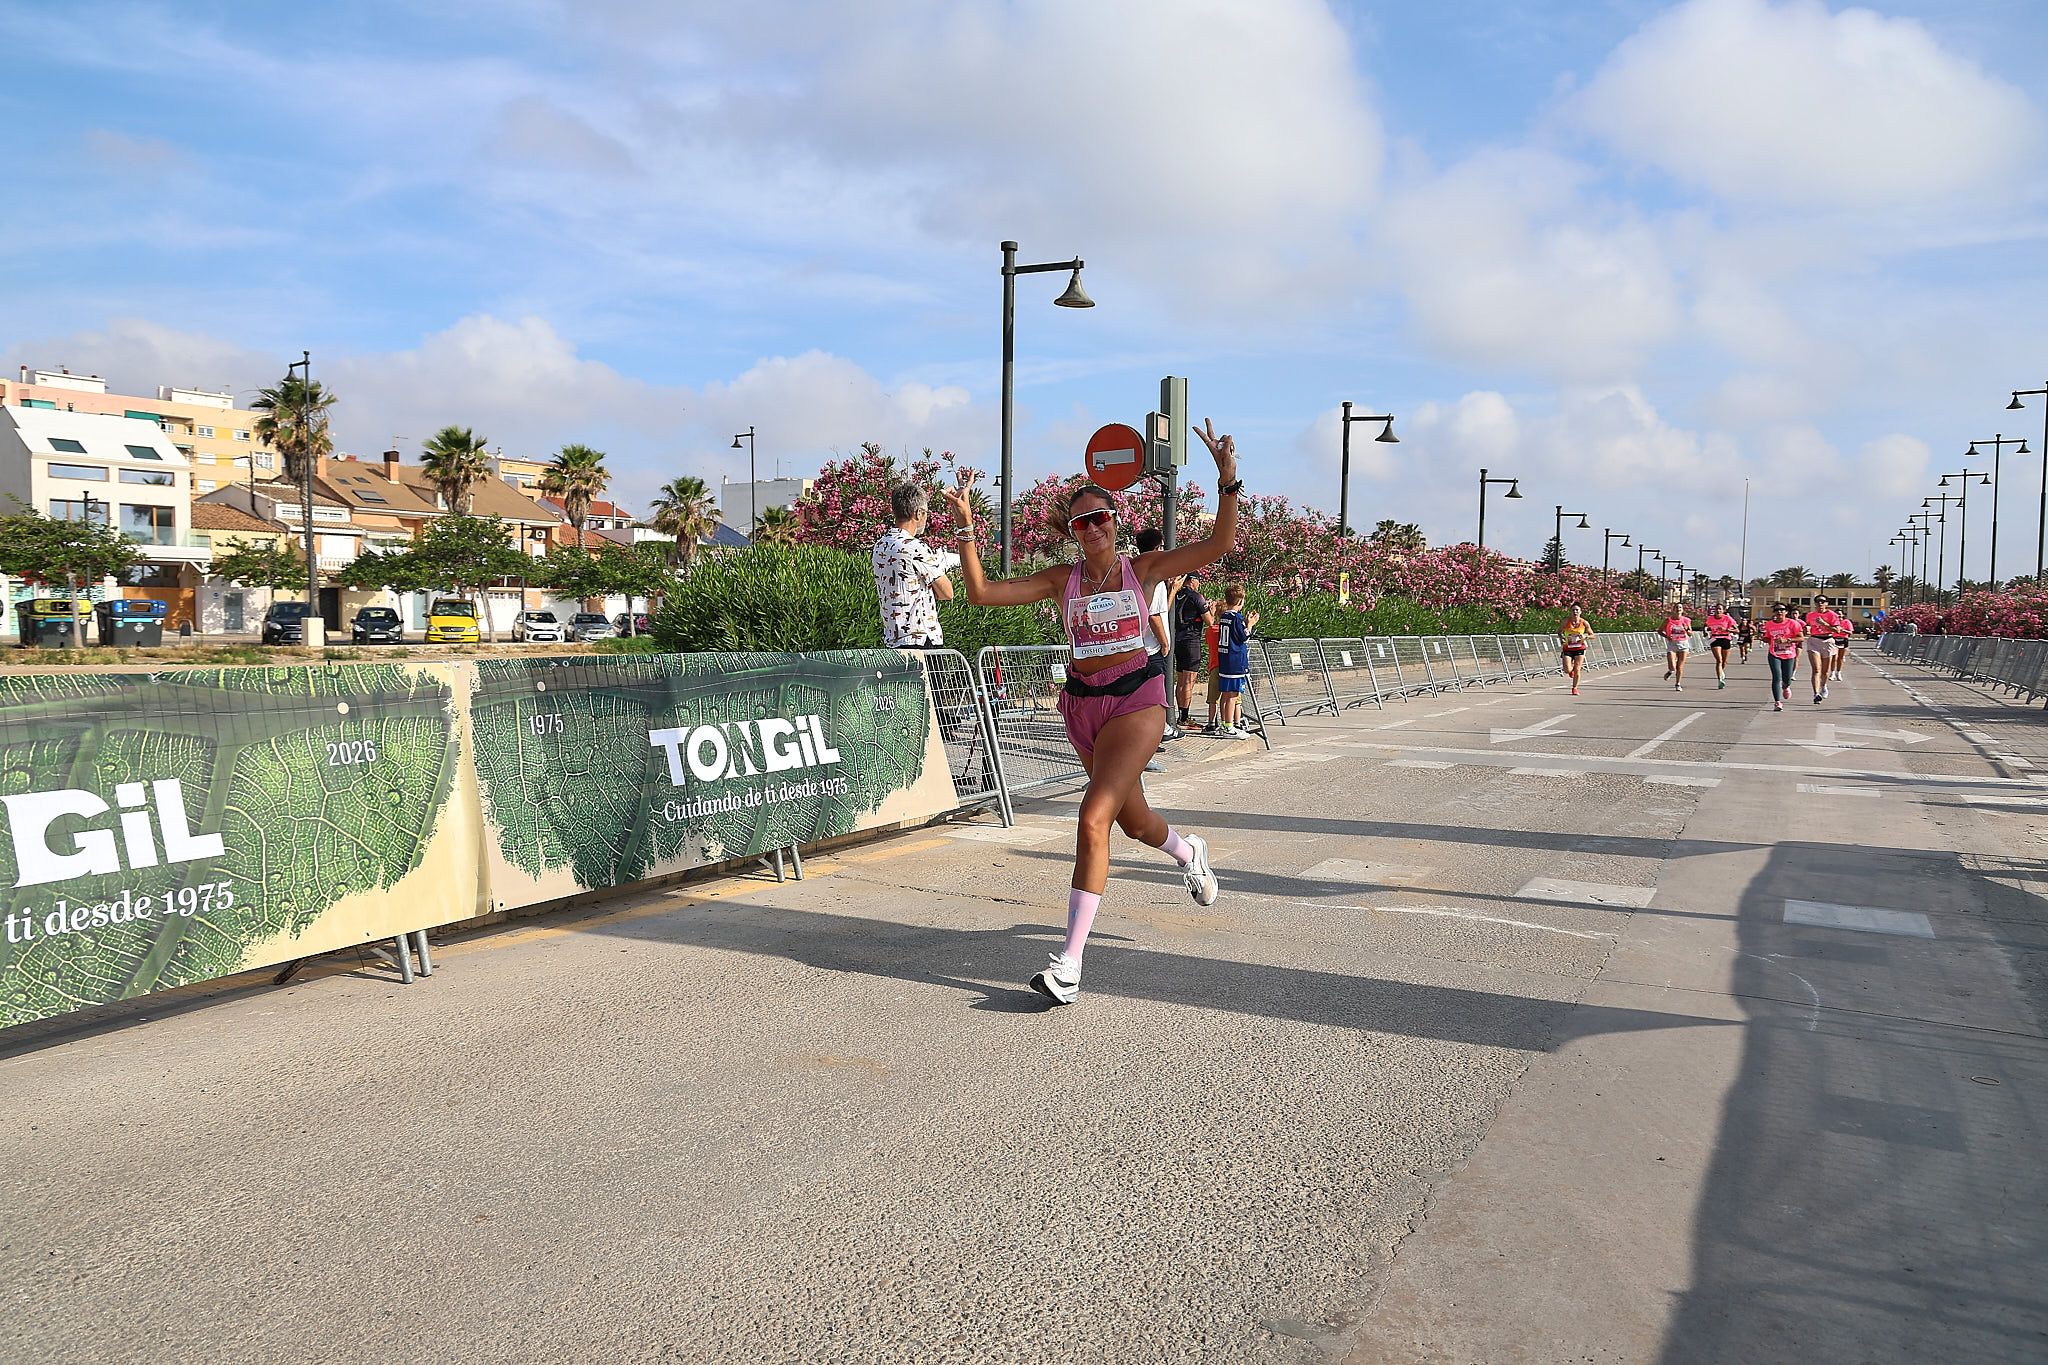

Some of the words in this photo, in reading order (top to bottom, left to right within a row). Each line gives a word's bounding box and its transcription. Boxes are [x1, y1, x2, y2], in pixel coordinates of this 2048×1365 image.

[1218, 625, 1229, 646] 10
[873, 695, 895, 713] 2026
[527, 712, 564, 736] 1975
[326, 739, 376, 766] 2026
[664, 791, 742, 822] Cuidando
[744, 787, 762, 806] de
[764, 786, 777, 805] ti
[779, 778, 817, 801] desde
[820, 776, 848, 797] 1975
[4, 911, 35, 944] ti
[45, 894, 153, 937] desde
[161, 880, 235, 916] 1975
